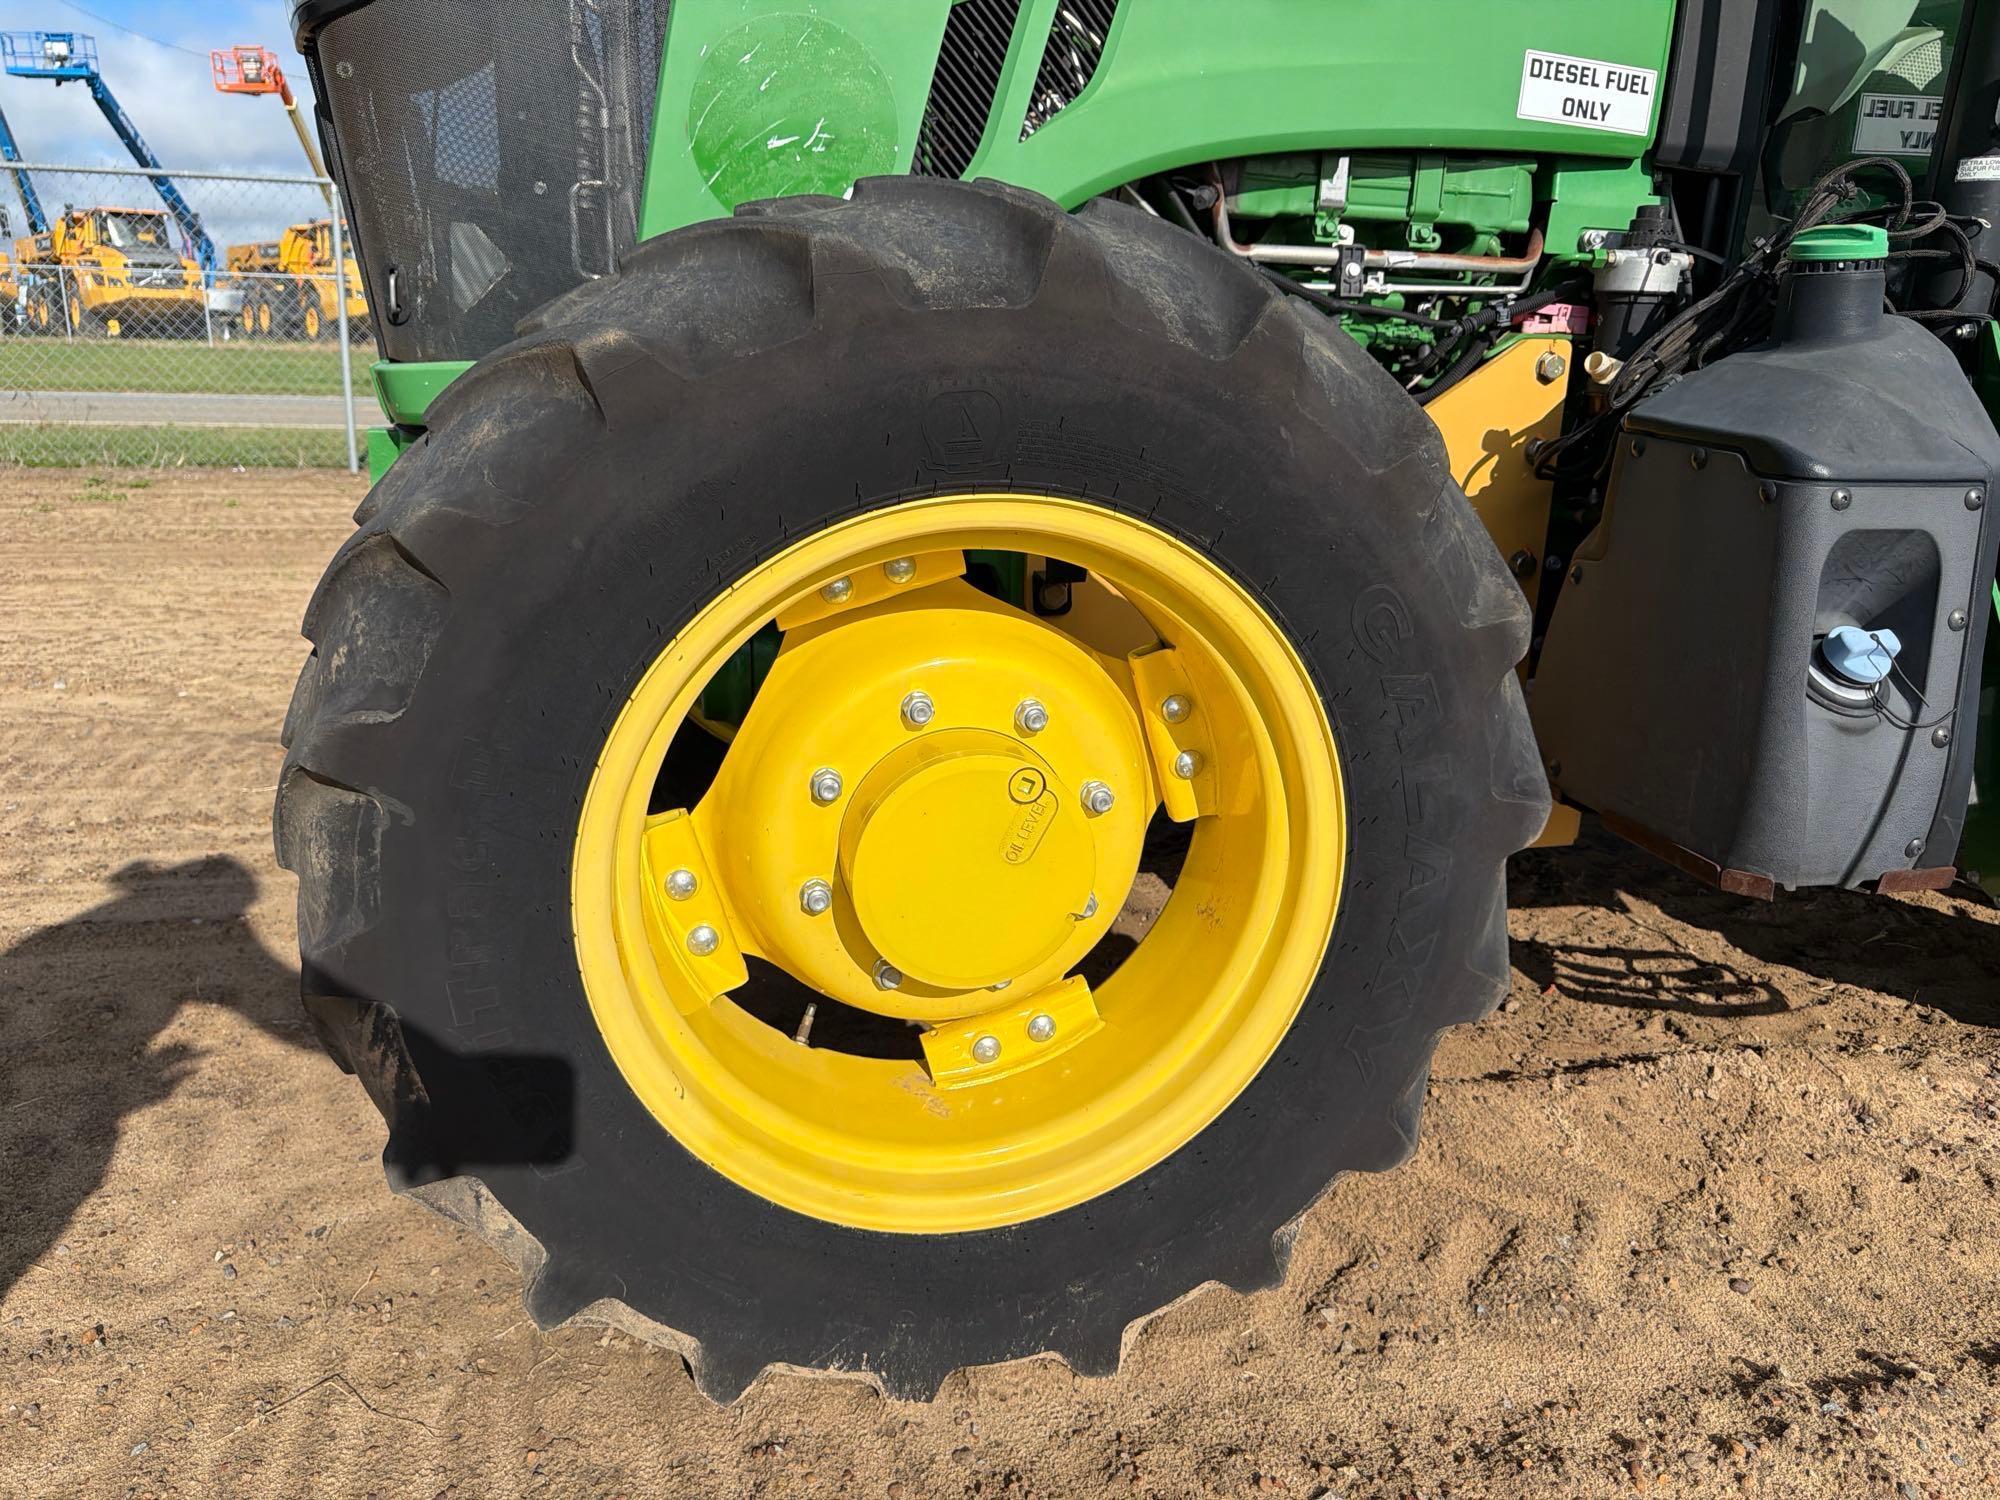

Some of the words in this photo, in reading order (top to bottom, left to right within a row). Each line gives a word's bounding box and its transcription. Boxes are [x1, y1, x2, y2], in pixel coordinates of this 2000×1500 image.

[1529, 58, 1600, 87] DIESEL
[1605, 70, 1649, 96] FUEL
[1561, 97, 1611, 122] ONLY
[1005, 842, 1025, 862] OIL
[1016, 801, 1048, 840] LEVEL
[1340, 584, 1450, 1087] GALAXY
